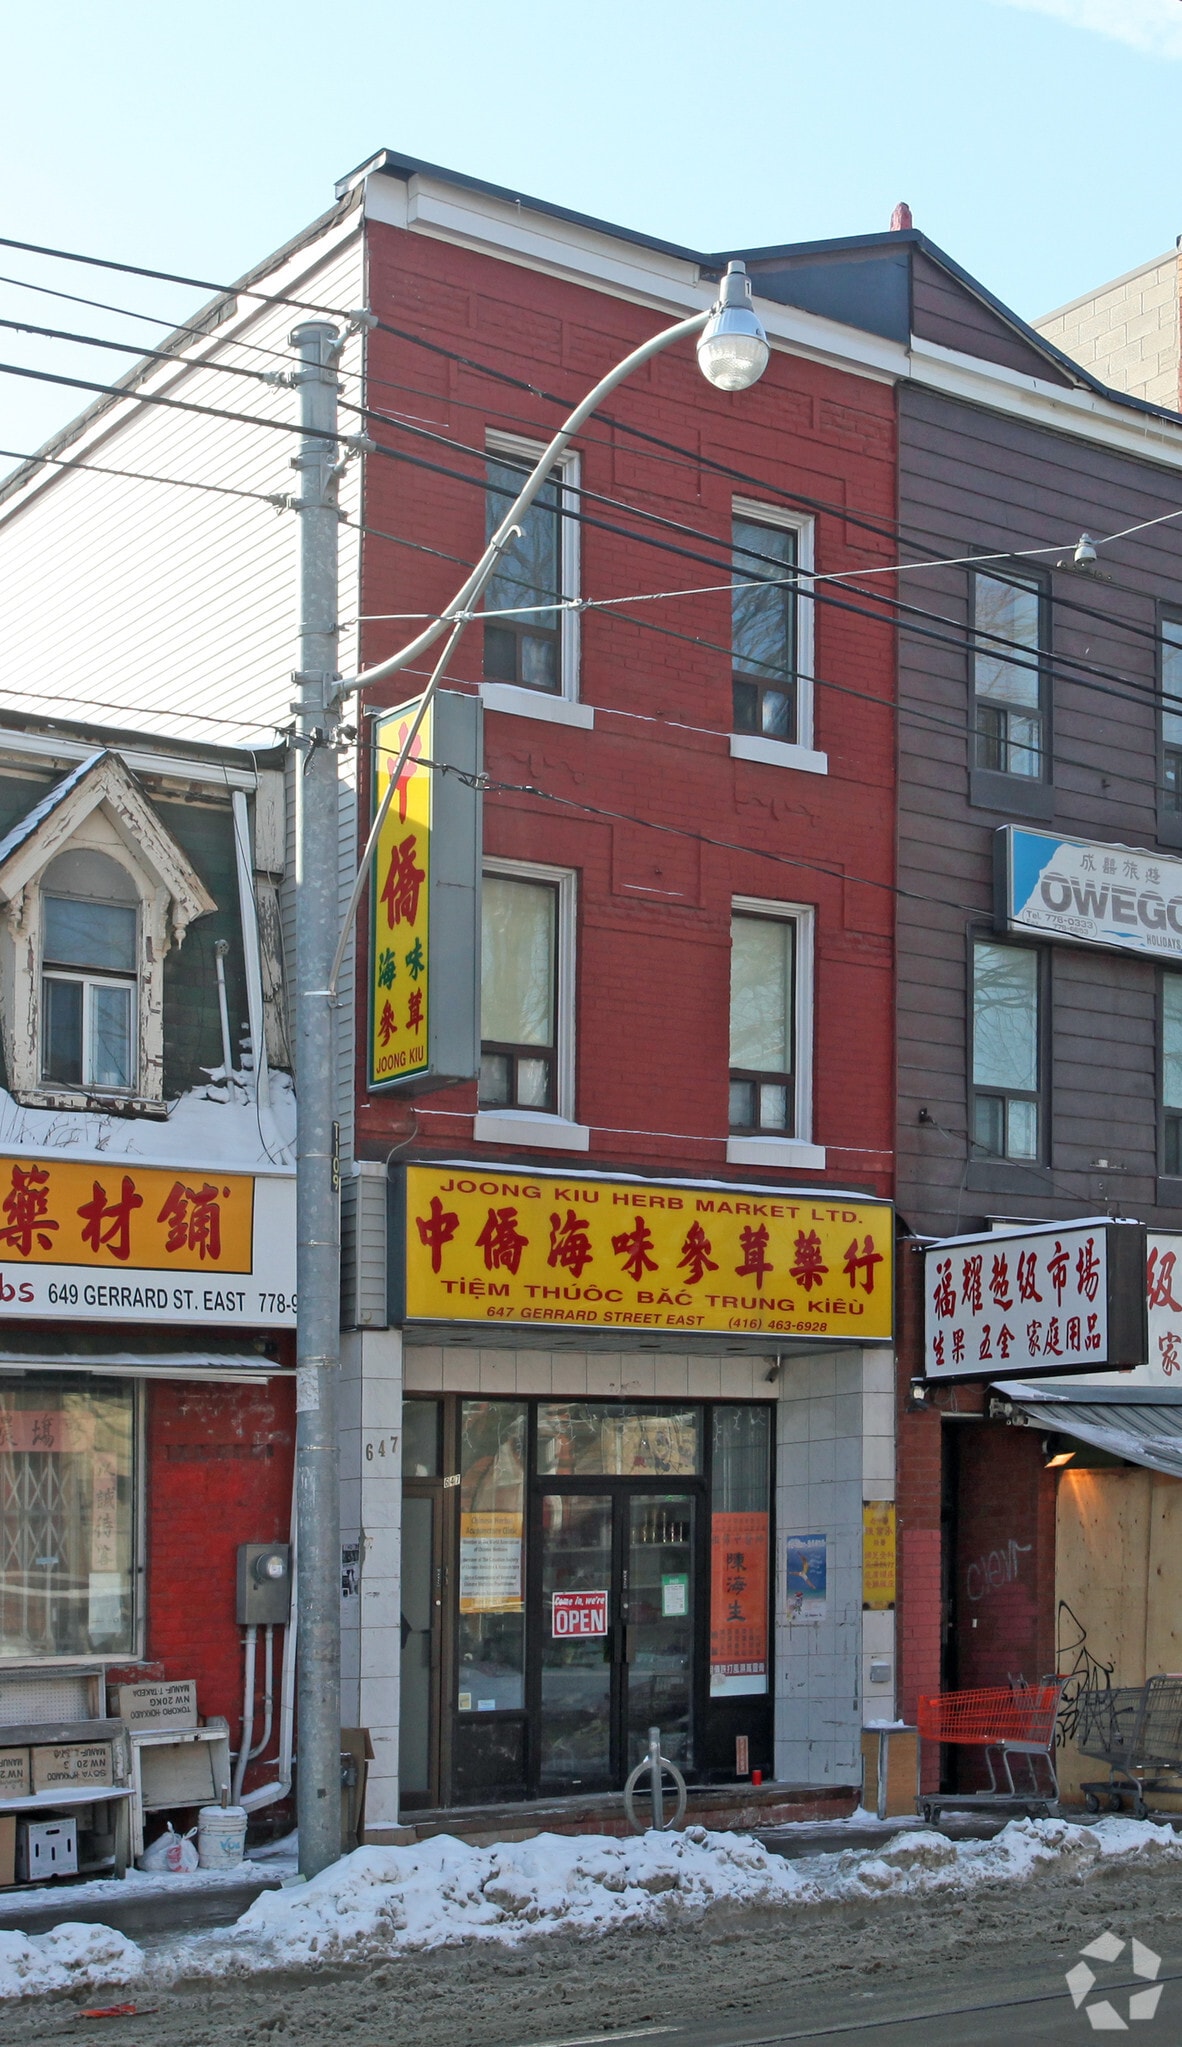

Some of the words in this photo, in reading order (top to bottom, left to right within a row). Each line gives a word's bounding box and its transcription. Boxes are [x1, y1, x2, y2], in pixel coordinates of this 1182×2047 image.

[1044, 913, 1094, 929] 778-0333
[376, 1051, 406, 1073] JOONG
[409, 1045, 424, 1064] KIU
[440, 1178, 541, 1199] JOONG
[554, 1188, 599, 1204] KIU
[612, 1193, 684, 1210] HERB
[696, 1199, 800, 1219] MARKET
[811, 1209, 863, 1224] LTD.
[48, 1283, 78, 1305] 649
[83, 1284, 168, 1309] GERRARD
[173, 1289, 198, 1310] ST.
[203, 1291, 246, 1312] EAST
[705, 1294, 795, 1312] TRUNG
[486, 1306, 515, 1318] 647
[520, 1307, 598, 1322] GERRARD
[603, 1311, 663, 1324] STREET
[666, 1314, 705, 1326] EAST
[728, 1317, 763, 1331] (416)
[767, 1319, 828, 1333] 463-6928
[365, 1435, 398, 1461] 647
[444, 1474, 460, 1488] 647
[554, 1597, 573, 1606] Come
[585, 1596, 605, 1605] we're
[556, 1608, 604, 1634] OPEN
[149, 1697, 173, 1707] 20KG
[175, 1695, 190, 1704] NW
[130, 1709, 161, 1720] HOKKAIDO
[162, 1706, 191, 1716] TOKORO
[90, 1758, 106, 1767] NW
[7, 1769, 23, 1779] NW
[81, 1769, 106, 1778] SOYA
